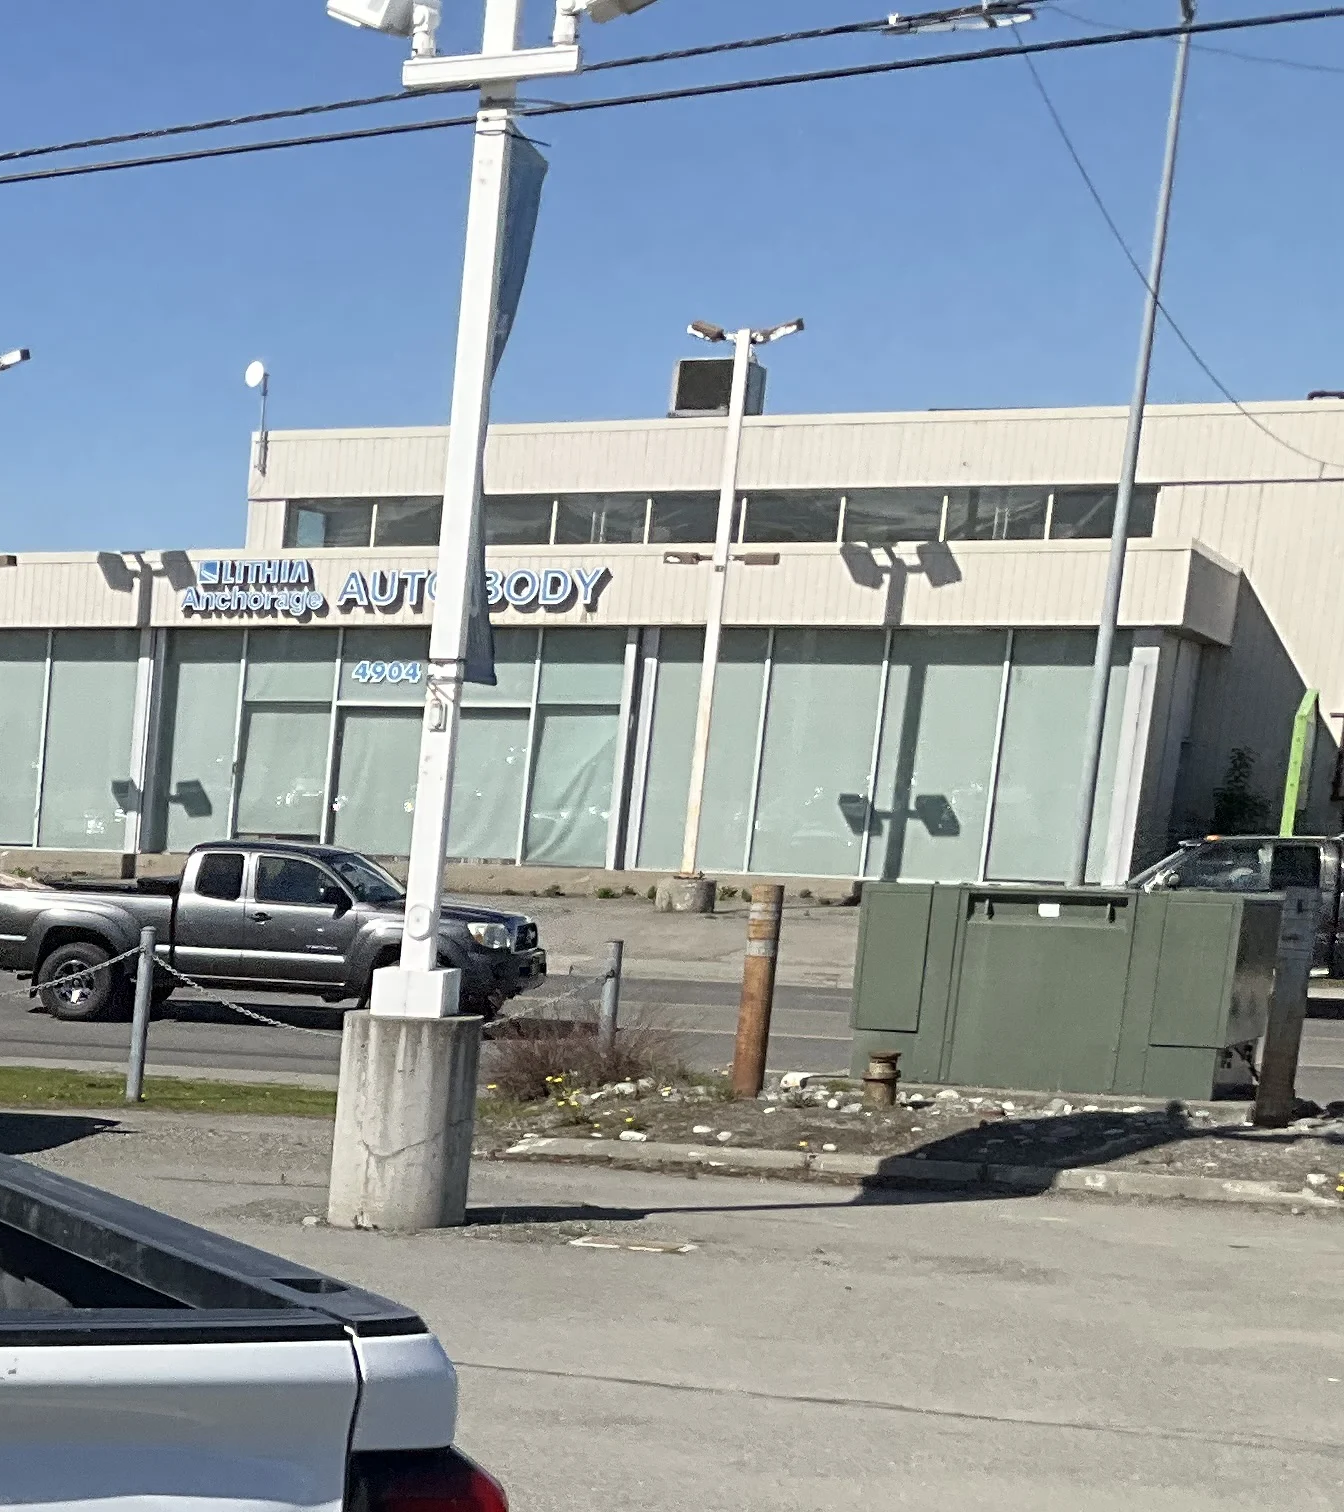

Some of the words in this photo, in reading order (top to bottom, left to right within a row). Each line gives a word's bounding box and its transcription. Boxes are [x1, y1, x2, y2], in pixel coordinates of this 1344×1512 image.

[222, 559, 310, 584] LITHIA
[181, 586, 324, 616] Anchorage
[338, 569, 439, 606] AUT
[351, 661, 422, 684] 4904
